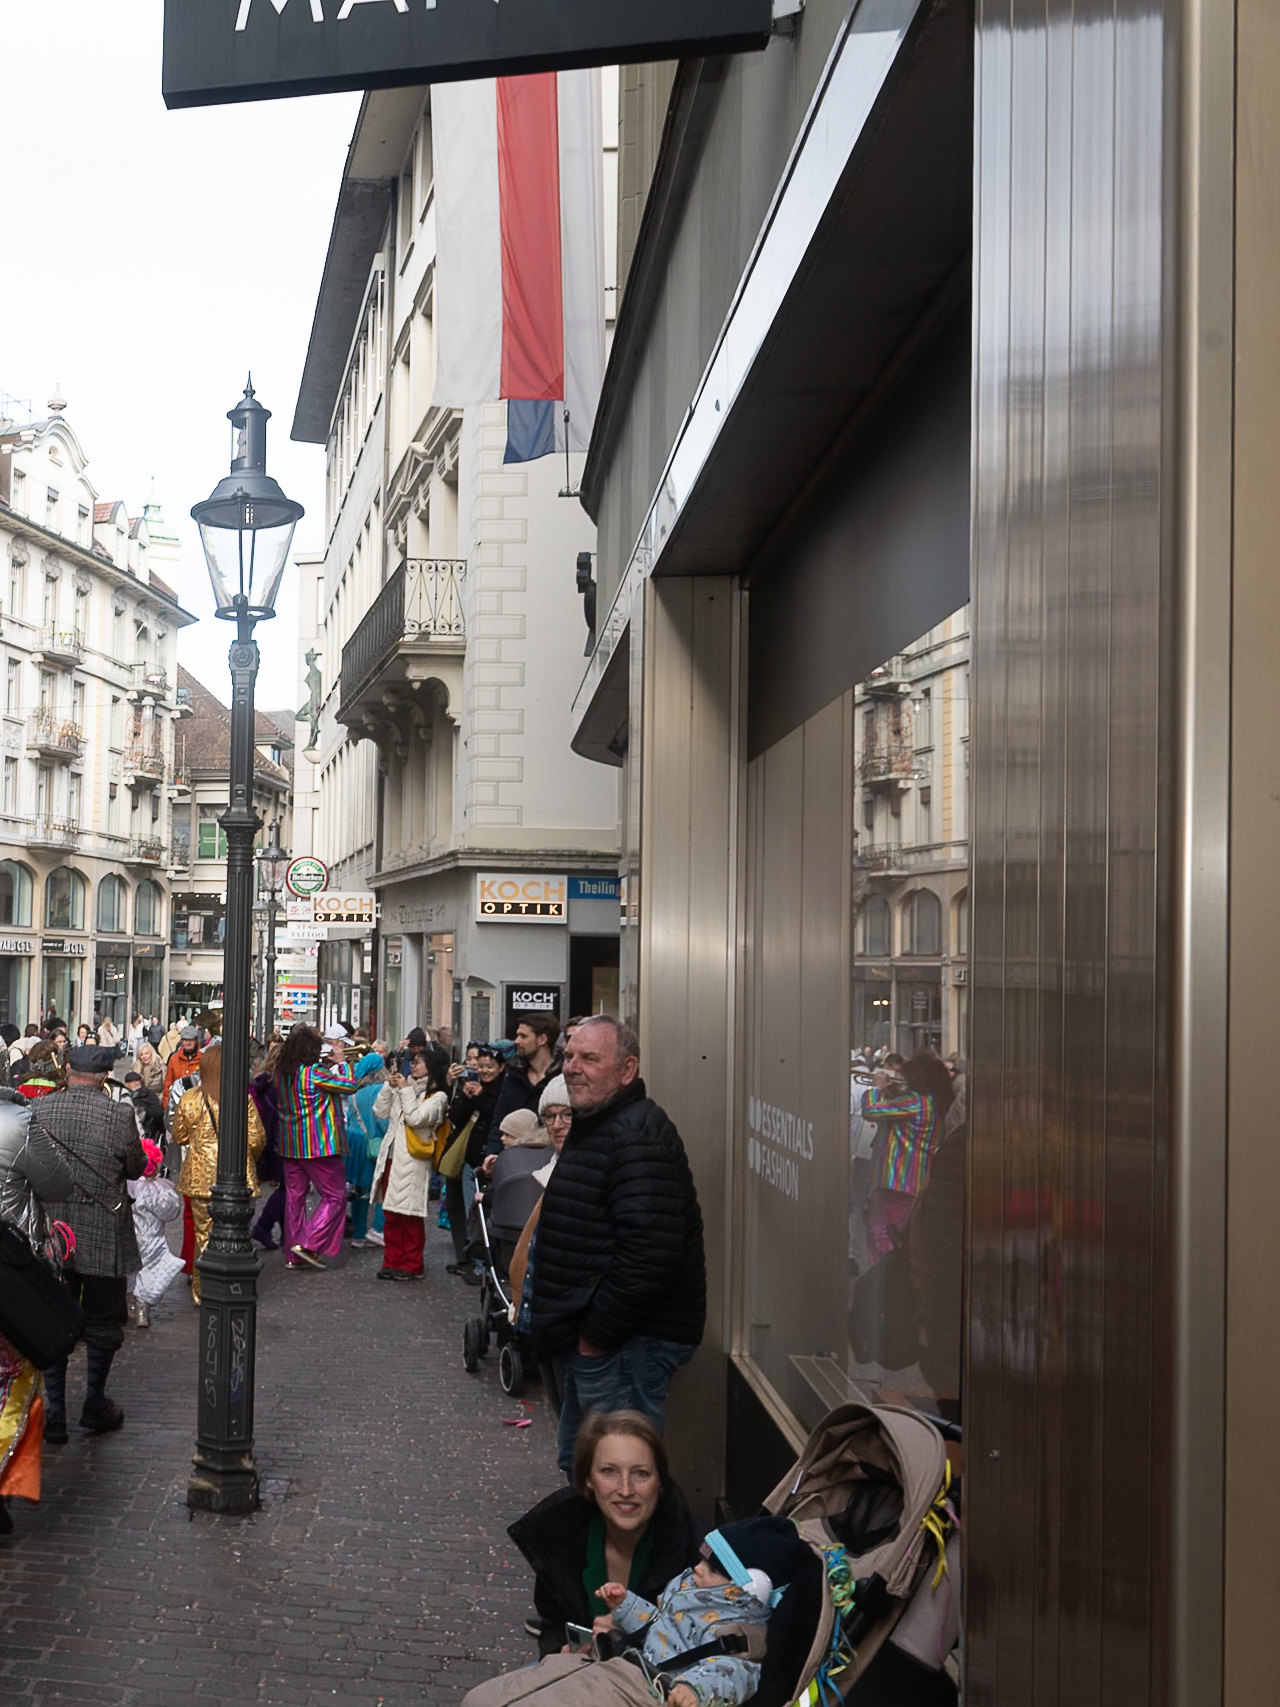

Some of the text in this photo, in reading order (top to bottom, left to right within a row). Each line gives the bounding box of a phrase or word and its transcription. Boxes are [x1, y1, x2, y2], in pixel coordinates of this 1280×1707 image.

[480, 880, 564, 901] KOCH
[313, 897, 374, 912] KOCH
[484, 902, 559, 916] OPTIK
[315, 913, 370, 922] OPTIK
[512, 991, 554, 1003] KOCH
[761, 1101, 814, 1161] ESSENTIALS
[761, 1144, 799, 1201] FASHION
